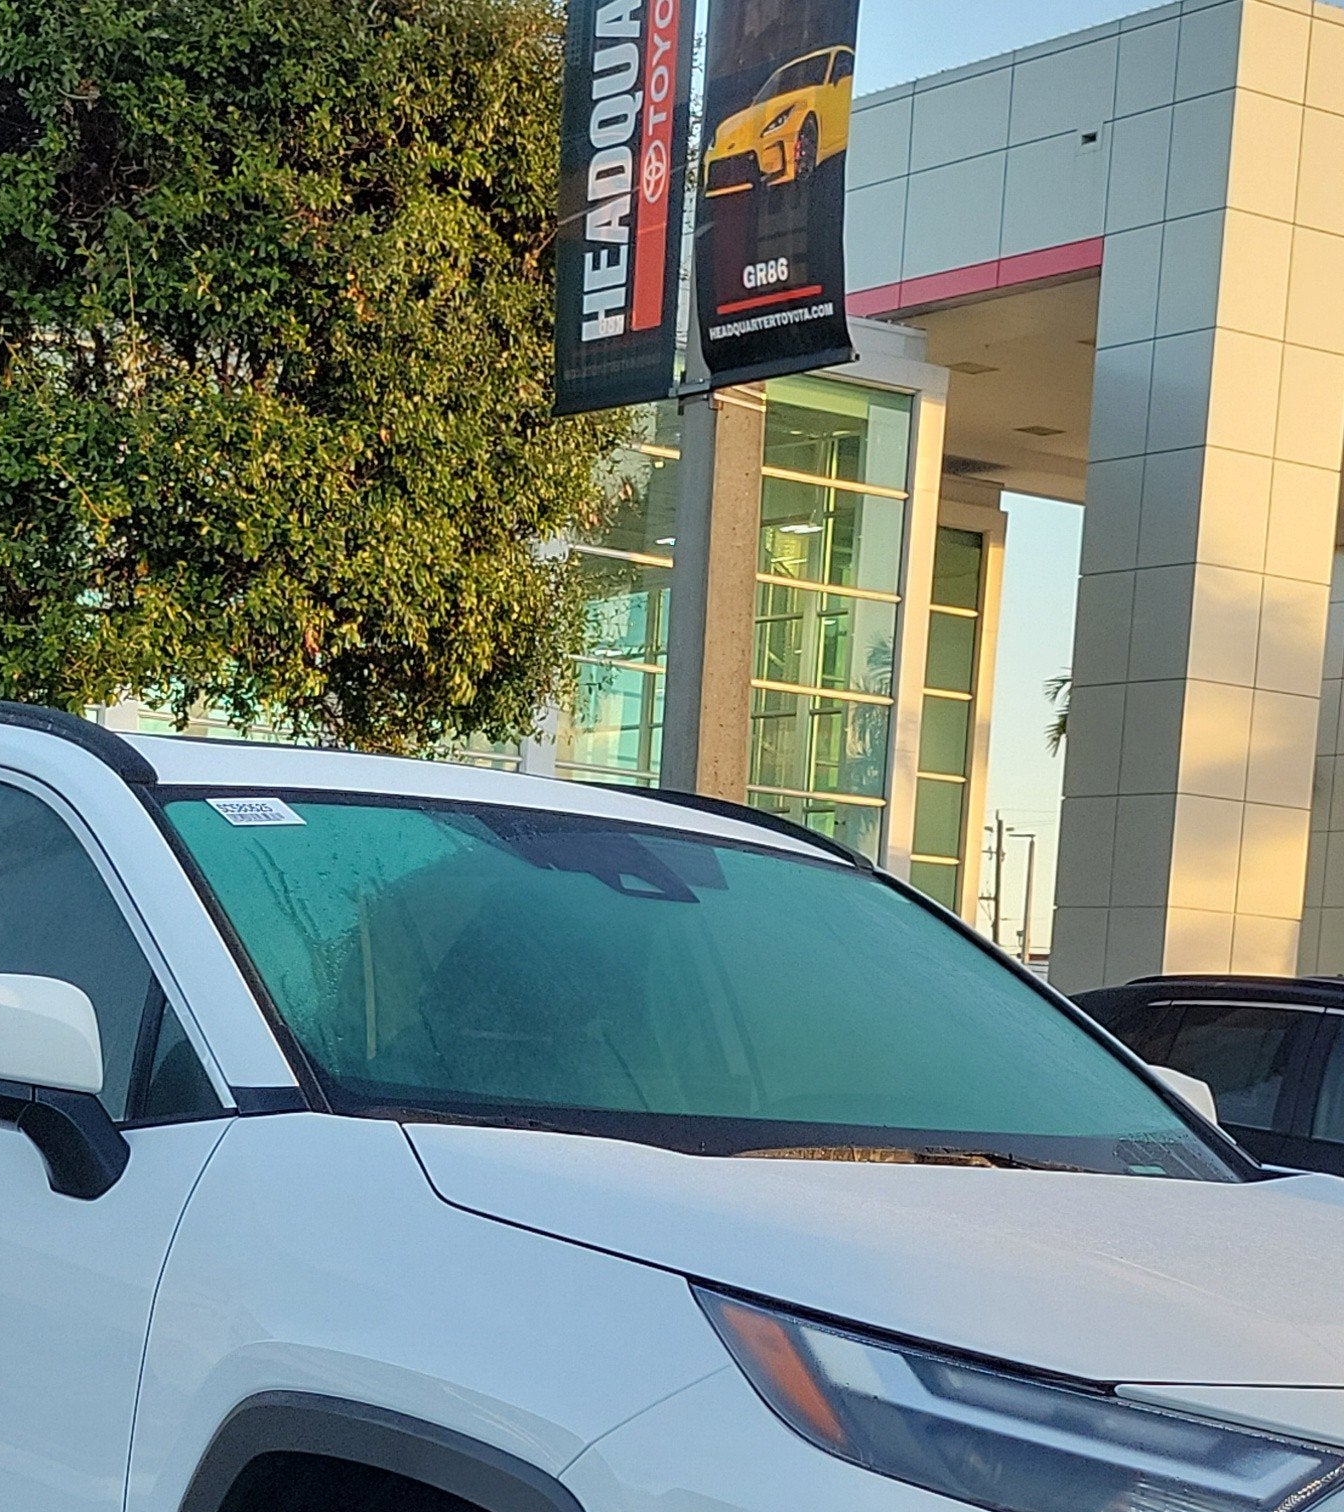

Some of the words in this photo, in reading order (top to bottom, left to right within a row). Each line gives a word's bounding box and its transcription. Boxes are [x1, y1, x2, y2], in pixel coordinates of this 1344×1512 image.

[648, 0, 674, 136] TOYO
[581, 0, 644, 342] HEADQUA
[742, 257, 789, 289] GR86
[709, 302, 834, 341] HEADQUARTERTOYOTA.COM
